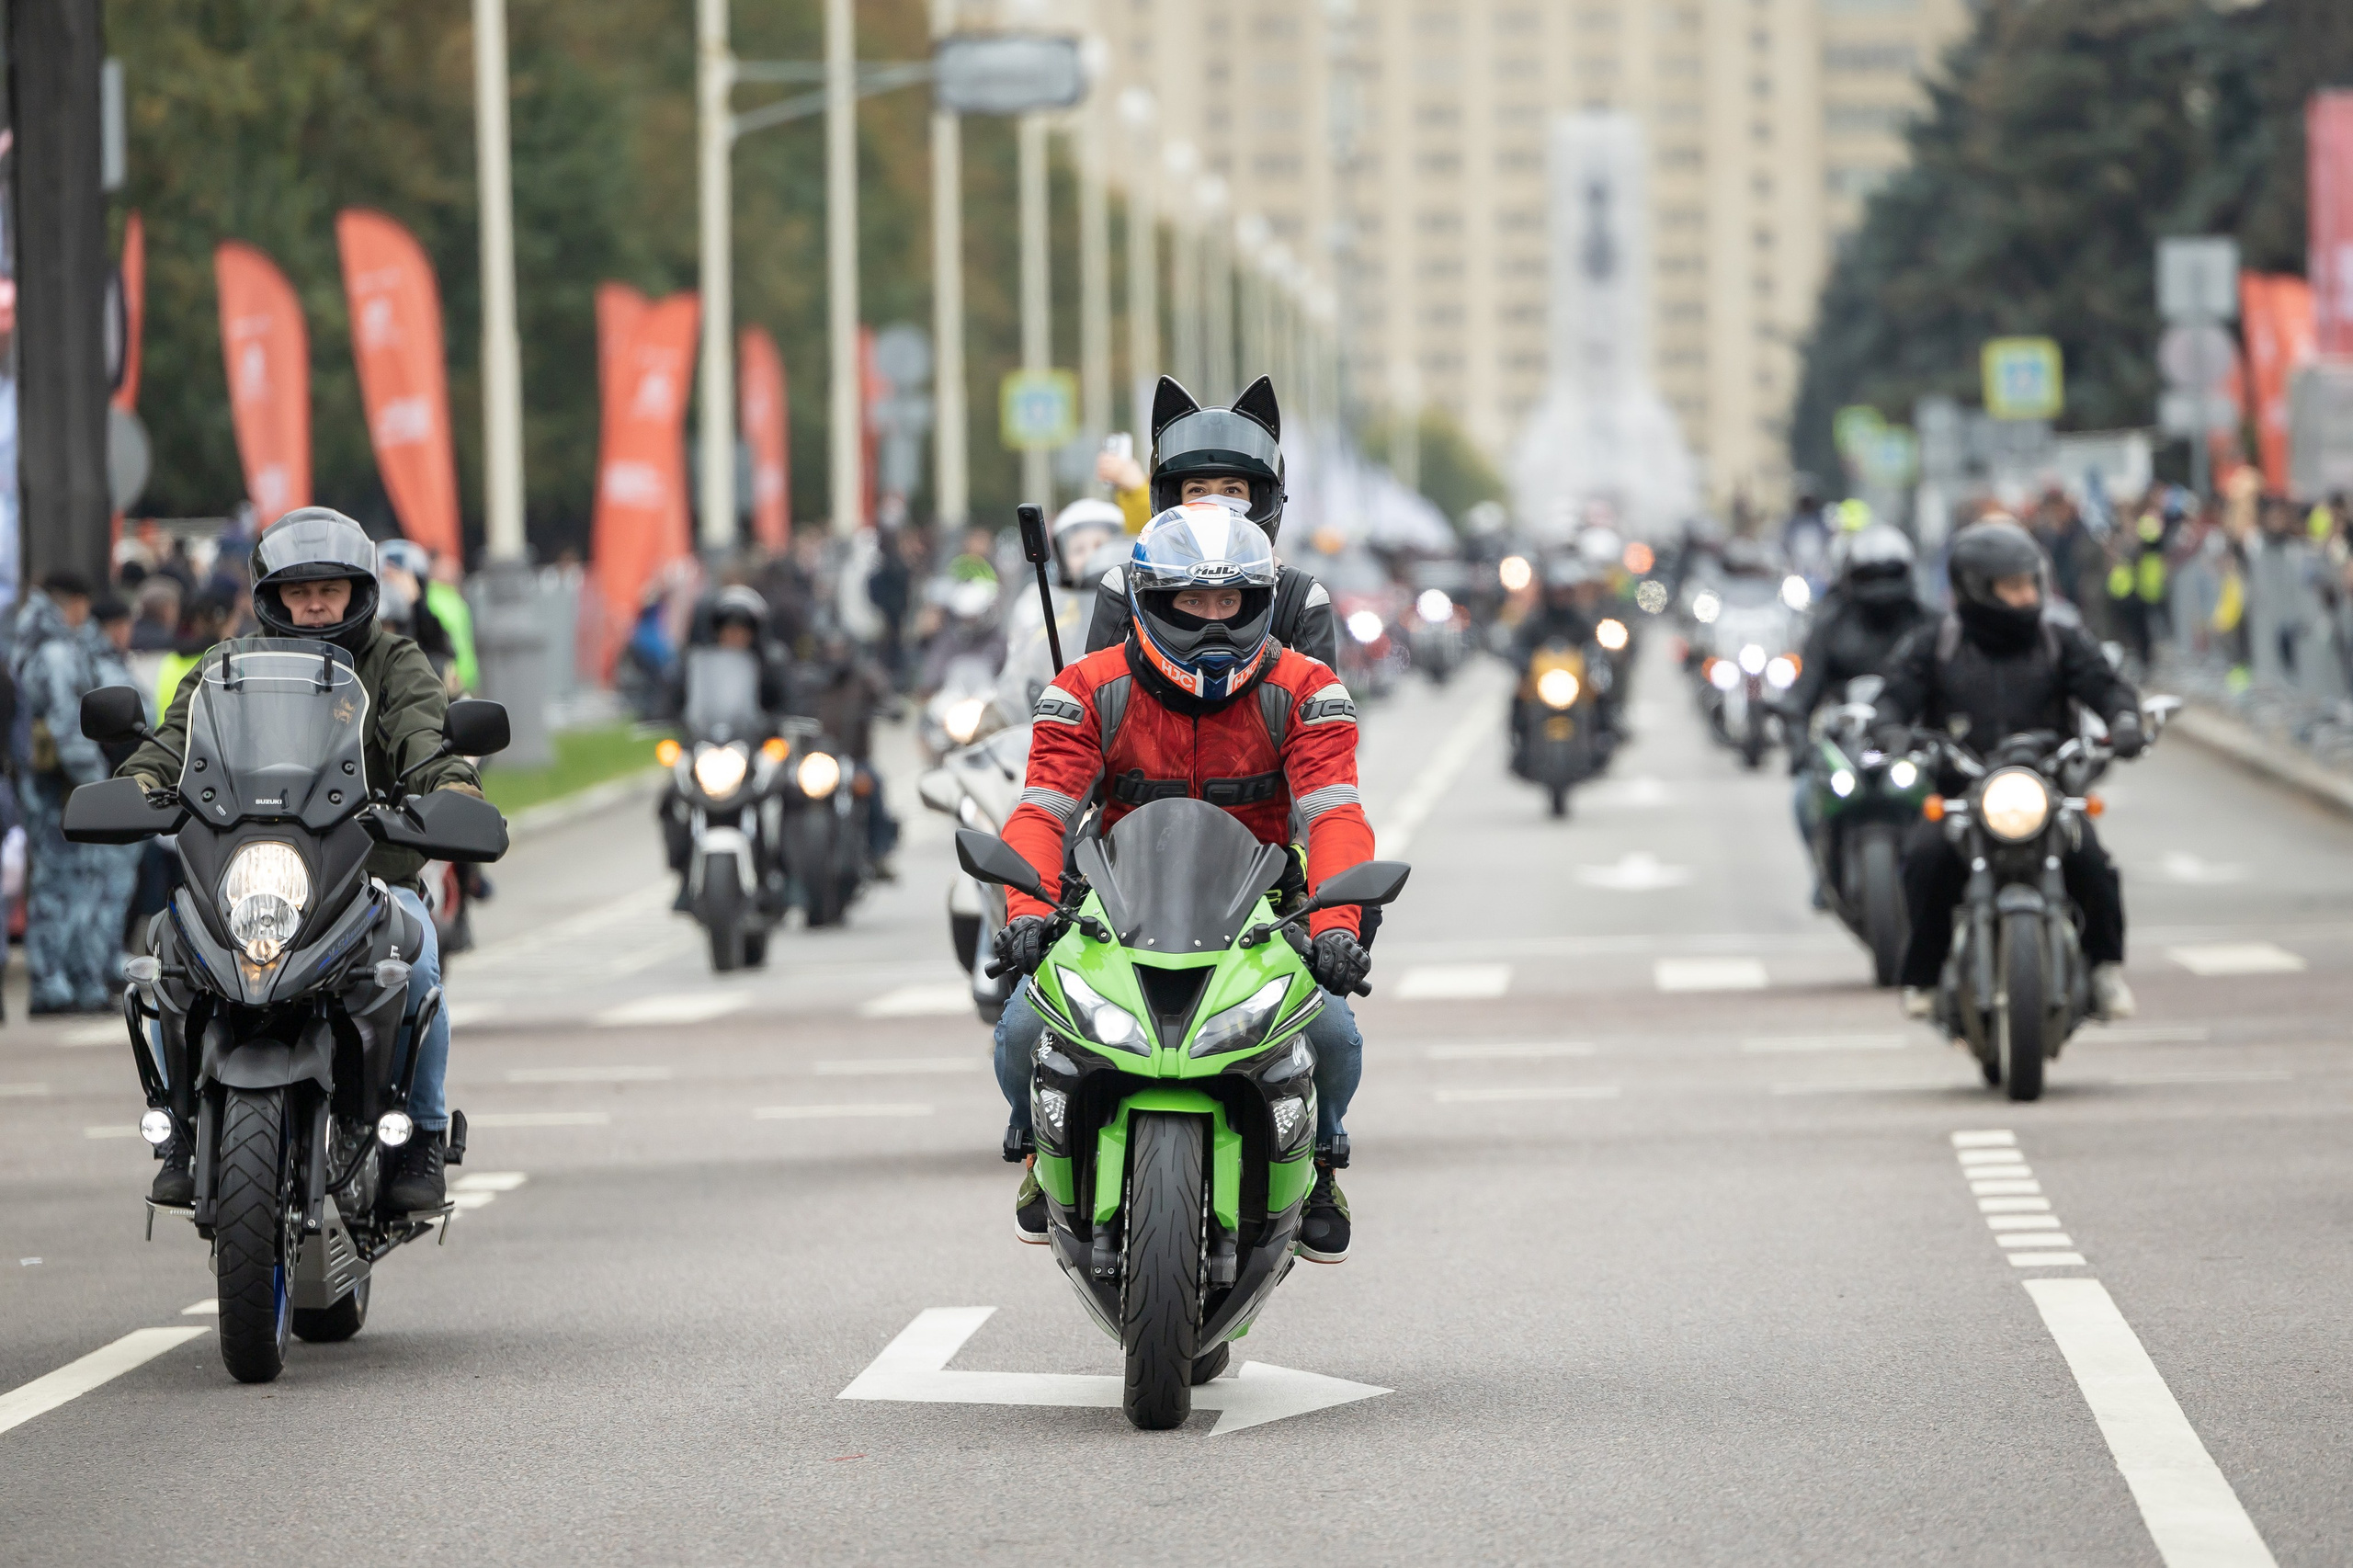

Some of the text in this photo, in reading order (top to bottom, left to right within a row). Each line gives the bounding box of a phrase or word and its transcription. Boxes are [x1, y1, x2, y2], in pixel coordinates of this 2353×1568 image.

[1193, 564, 1237, 575] HJC
[1161, 659, 1194, 688] HJC
[1233, 660, 1259, 689] HJC
[1032, 699, 1085, 723] con
[1299, 696, 1358, 722] ico
